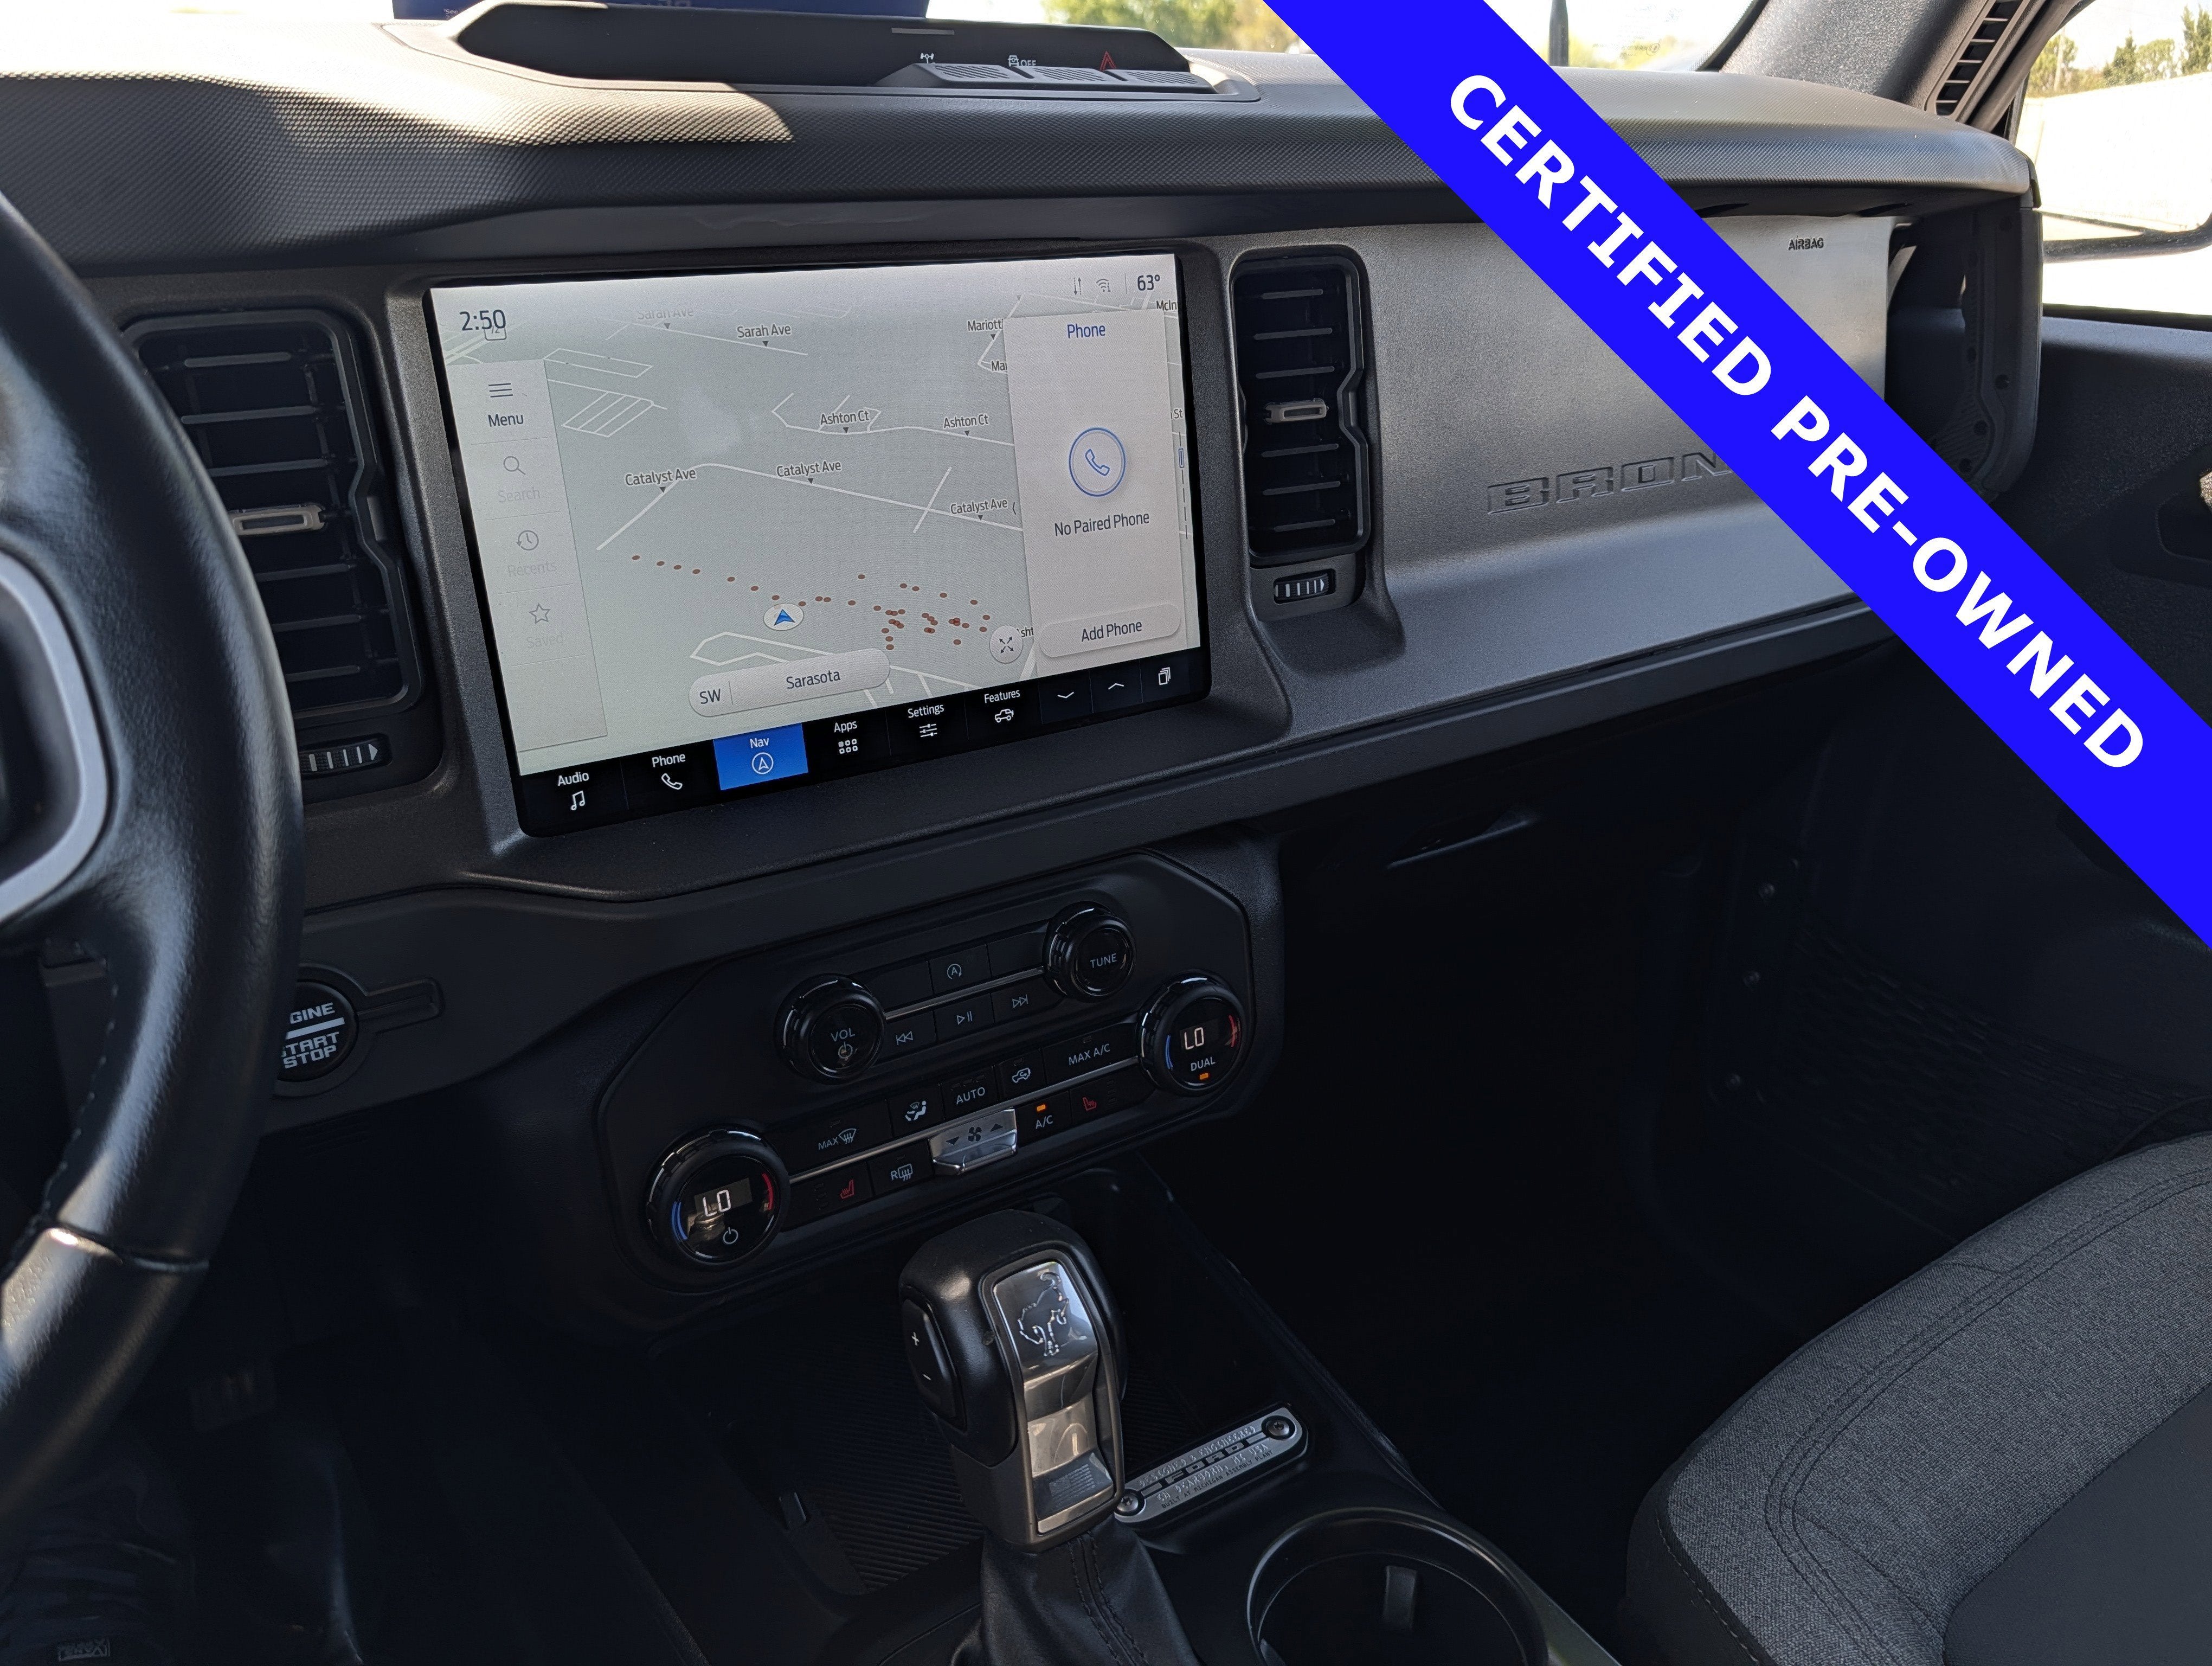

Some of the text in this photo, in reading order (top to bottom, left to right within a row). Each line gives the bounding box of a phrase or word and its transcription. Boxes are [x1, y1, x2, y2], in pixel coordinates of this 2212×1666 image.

[1788, 237, 1824, 251] AIRBAG
[1156, 299, 1178, 311] McIn
[459, 309, 506, 331] 2:50
[737, 324, 791, 338] Sarah Ave
[1068, 323, 1105, 339] Phone
[488, 414, 524, 427] Menu
[820, 411, 869, 426] Ashton Ct
[1174, 408, 1183, 419] St
[943, 414, 989, 430] Ashton Ct
[776, 461, 842, 477] Catalyst Ave
[625, 468, 696, 486] Catalyst Ave
[1487, 451, 1733, 515] BRON
[498, 488, 541, 503] Search
[950, 504, 989, 516] Catalyst
[989, 502, 1008, 512] Ave
[1054, 513, 1150, 536] No Paired Phone
[507, 561, 557, 577] Recents
[1081, 621, 1142, 642] Add Phone
[526, 633, 564, 648] Saved
[786, 670, 841, 689] Sarasota
[699, 689, 722, 704] SW
[984, 689, 1020, 703] Features
[908, 703, 944, 719] Settings
[834, 720, 857, 733] Apps
[750, 736, 769, 748] Nav
[652, 752, 686, 767] Phone
[557, 771, 589, 786] Audio
[1090, 953, 1117, 967] TUNE
[290, 1002, 335, 1024] GINE
[830, 1027, 856, 1041] VOL
[283, 1045, 337, 1069] STOP
[1068, 1043, 1110, 1066] MAX A/C
[1190, 1056, 1216, 1072] DUAL
[956, 1087, 986, 1105] AUTO
[1035, 1115, 1053, 1130] A/C
[818, 1137, 839, 1150] MAX
[891, 1170, 897, 1181] R
[1248, 1443, 1268, 1456] USA
[1165, 1442, 1244, 1484] FORD
[1161, 1496, 1181, 1509] BUILT
[1194, 1475, 1224, 1492] MICHIGAN
[1226, 1460, 1253, 1477] ASSEMBLY
[1256, 1450, 1273, 1462] PLANT
